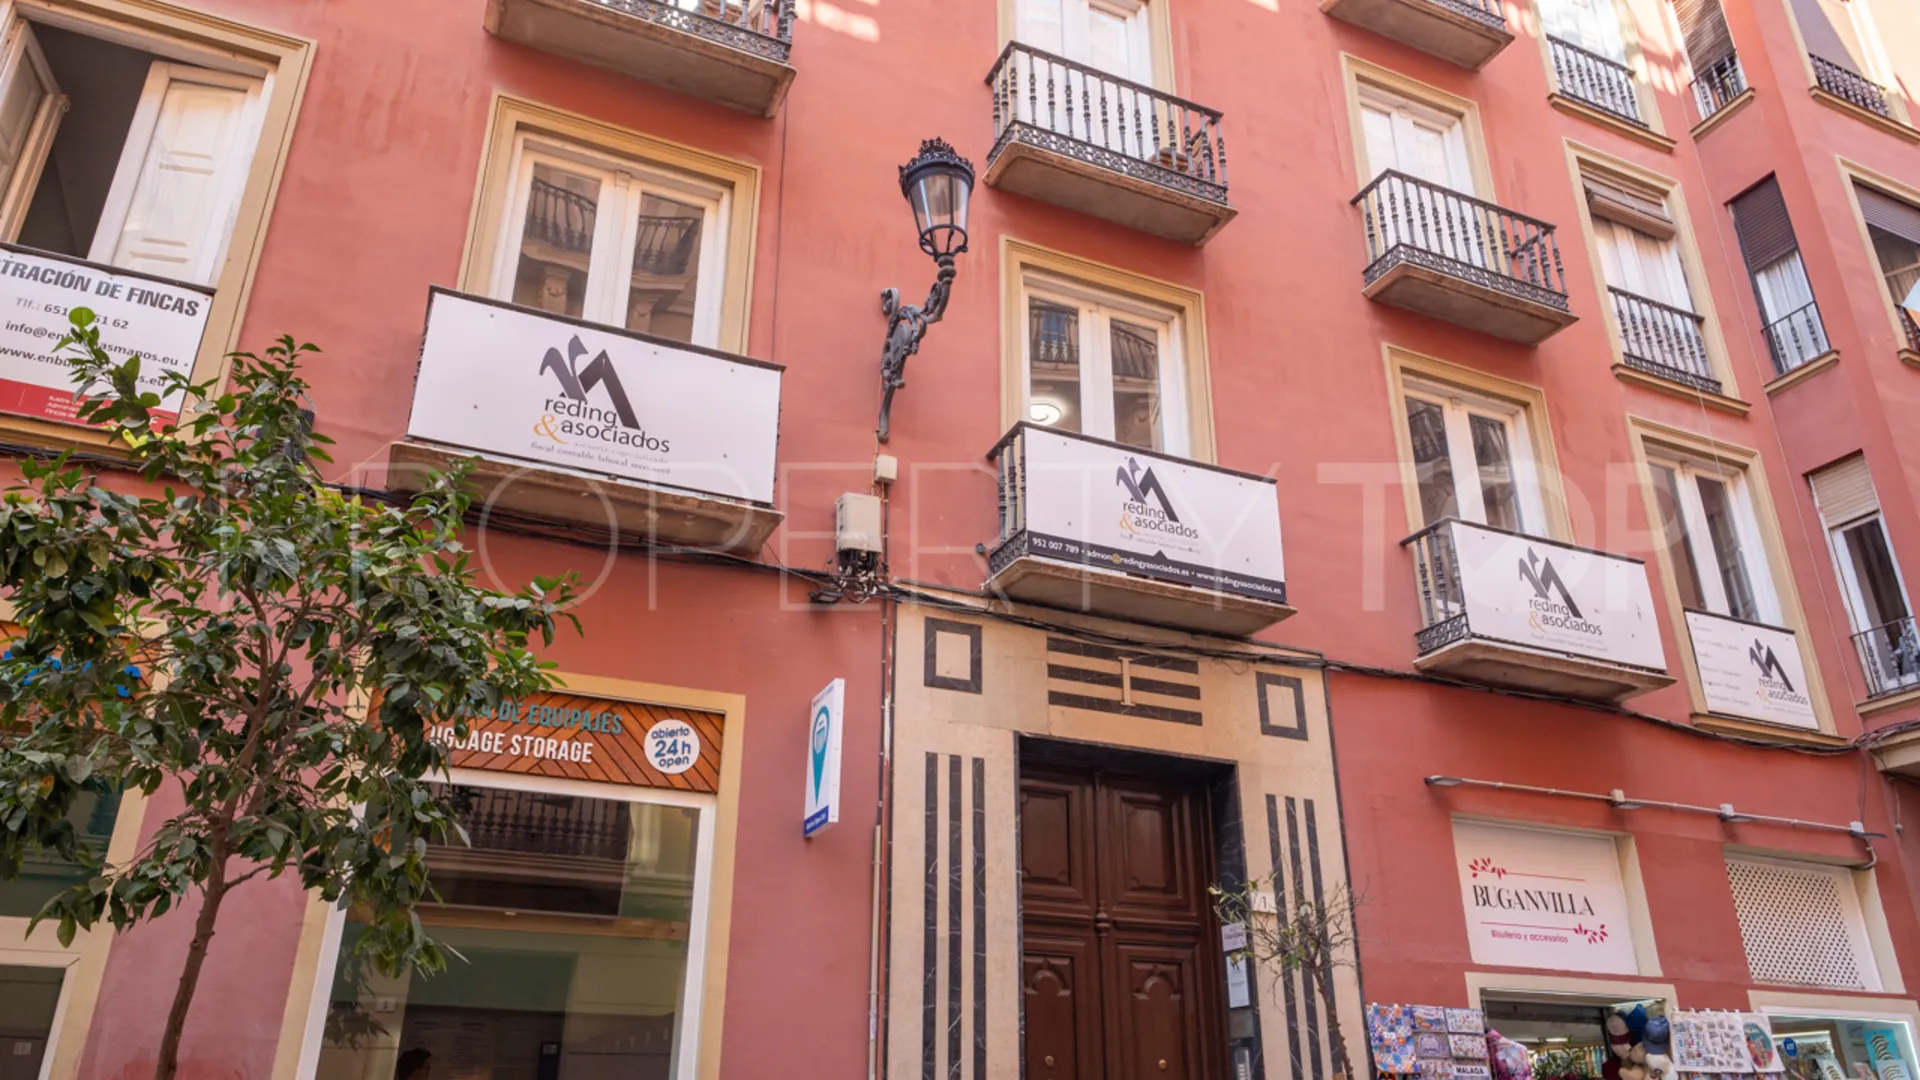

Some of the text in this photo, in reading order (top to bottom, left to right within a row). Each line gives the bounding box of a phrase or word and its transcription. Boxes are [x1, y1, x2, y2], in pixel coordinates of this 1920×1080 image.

[0, 258, 200, 317] TRACIÓN DE FINCAS
[44, 304, 68, 316] 651
[112, 319, 129, 330] 62
[545, 398, 618, 428] reding
[561, 420, 670, 453] asociados
[1122, 500, 1166, 522] reding
[1134, 517, 1199, 539] asociados
[1032, 537, 1047, 548] 952
[1048, 541, 1063, 551] 007
[1529, 599, 1571, 619] reding
[1542, 614, 1603, 636] asociados
[527, 703, 623, 735] EQUIPAJES
[651, 726, 690, 739] abierto
[509, 734, 593, 763] STORAGE
[658, 756, 689, 768] open
[1472, 884, 1595, 916] BUGANVILLA
